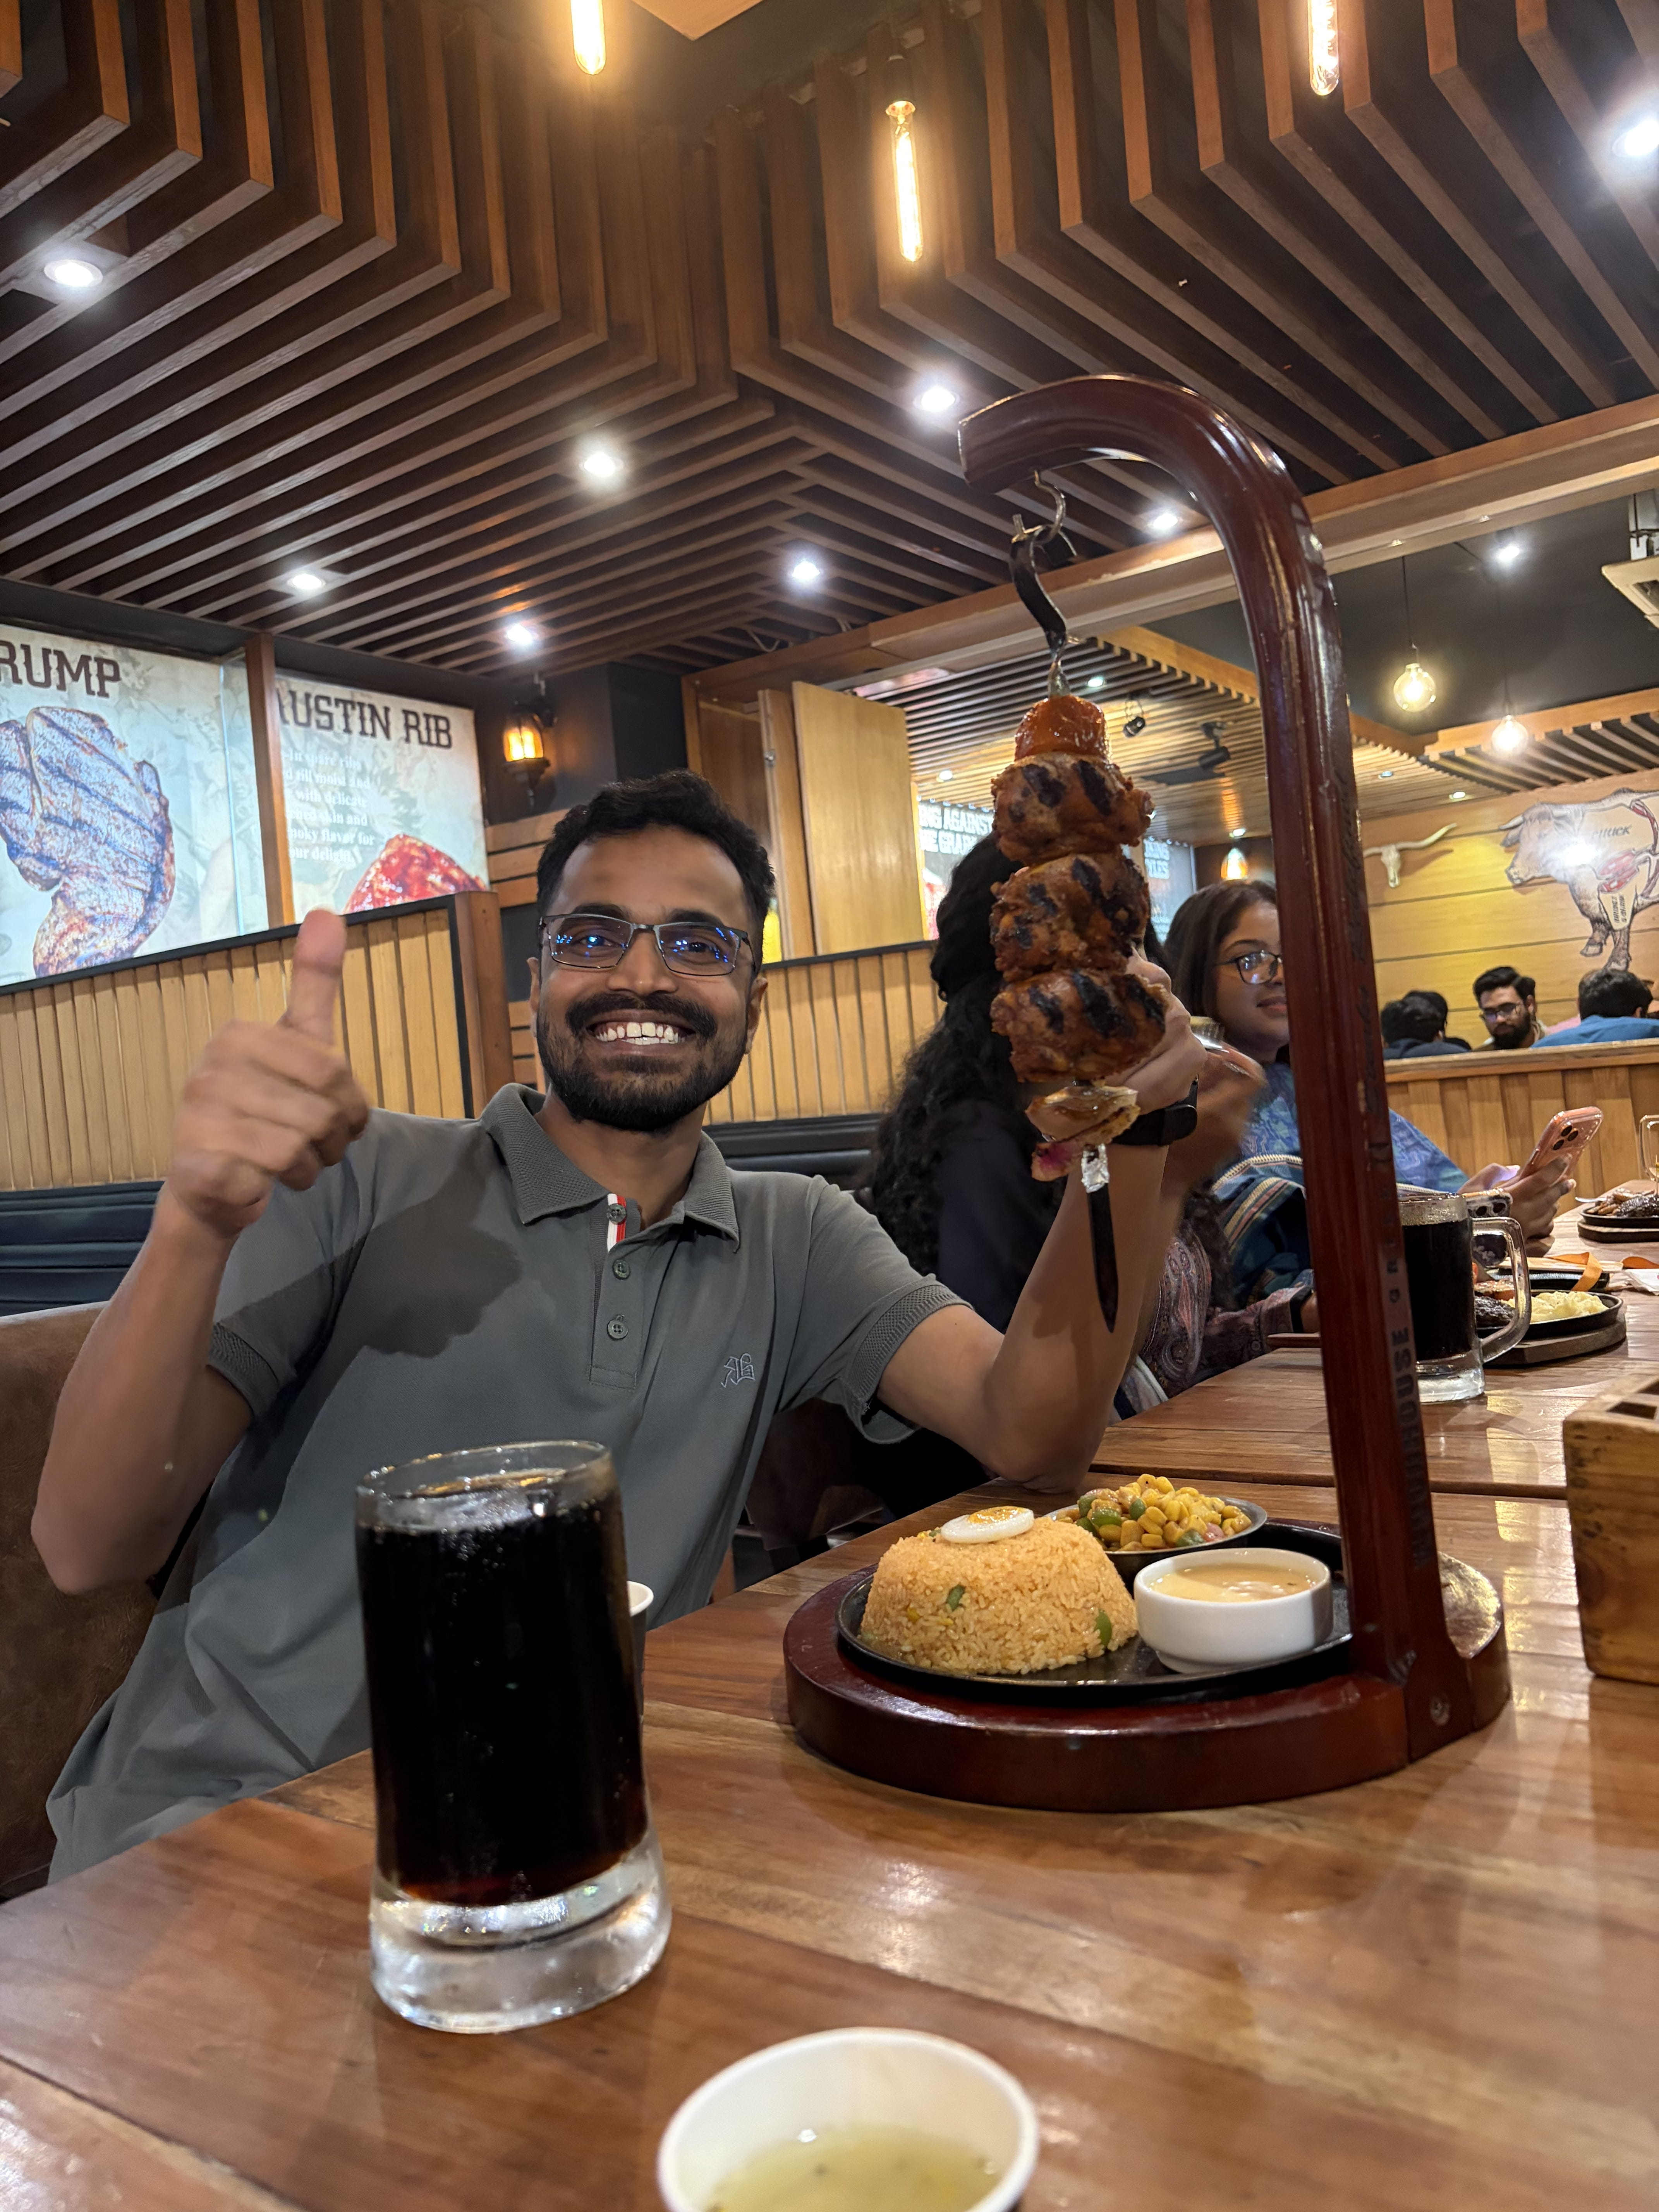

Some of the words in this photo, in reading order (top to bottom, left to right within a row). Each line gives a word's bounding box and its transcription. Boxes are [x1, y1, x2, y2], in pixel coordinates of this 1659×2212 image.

[0, 640, 121, 698] RUMP
[402, 709, 452, 749] RIB
[349, 775, 371, 789] and
[295, 788, 322, 803] with
[347, 813, 368, 826] and
[321, 828, 356, 844] flavor
[357, 832, 376, 845] for
